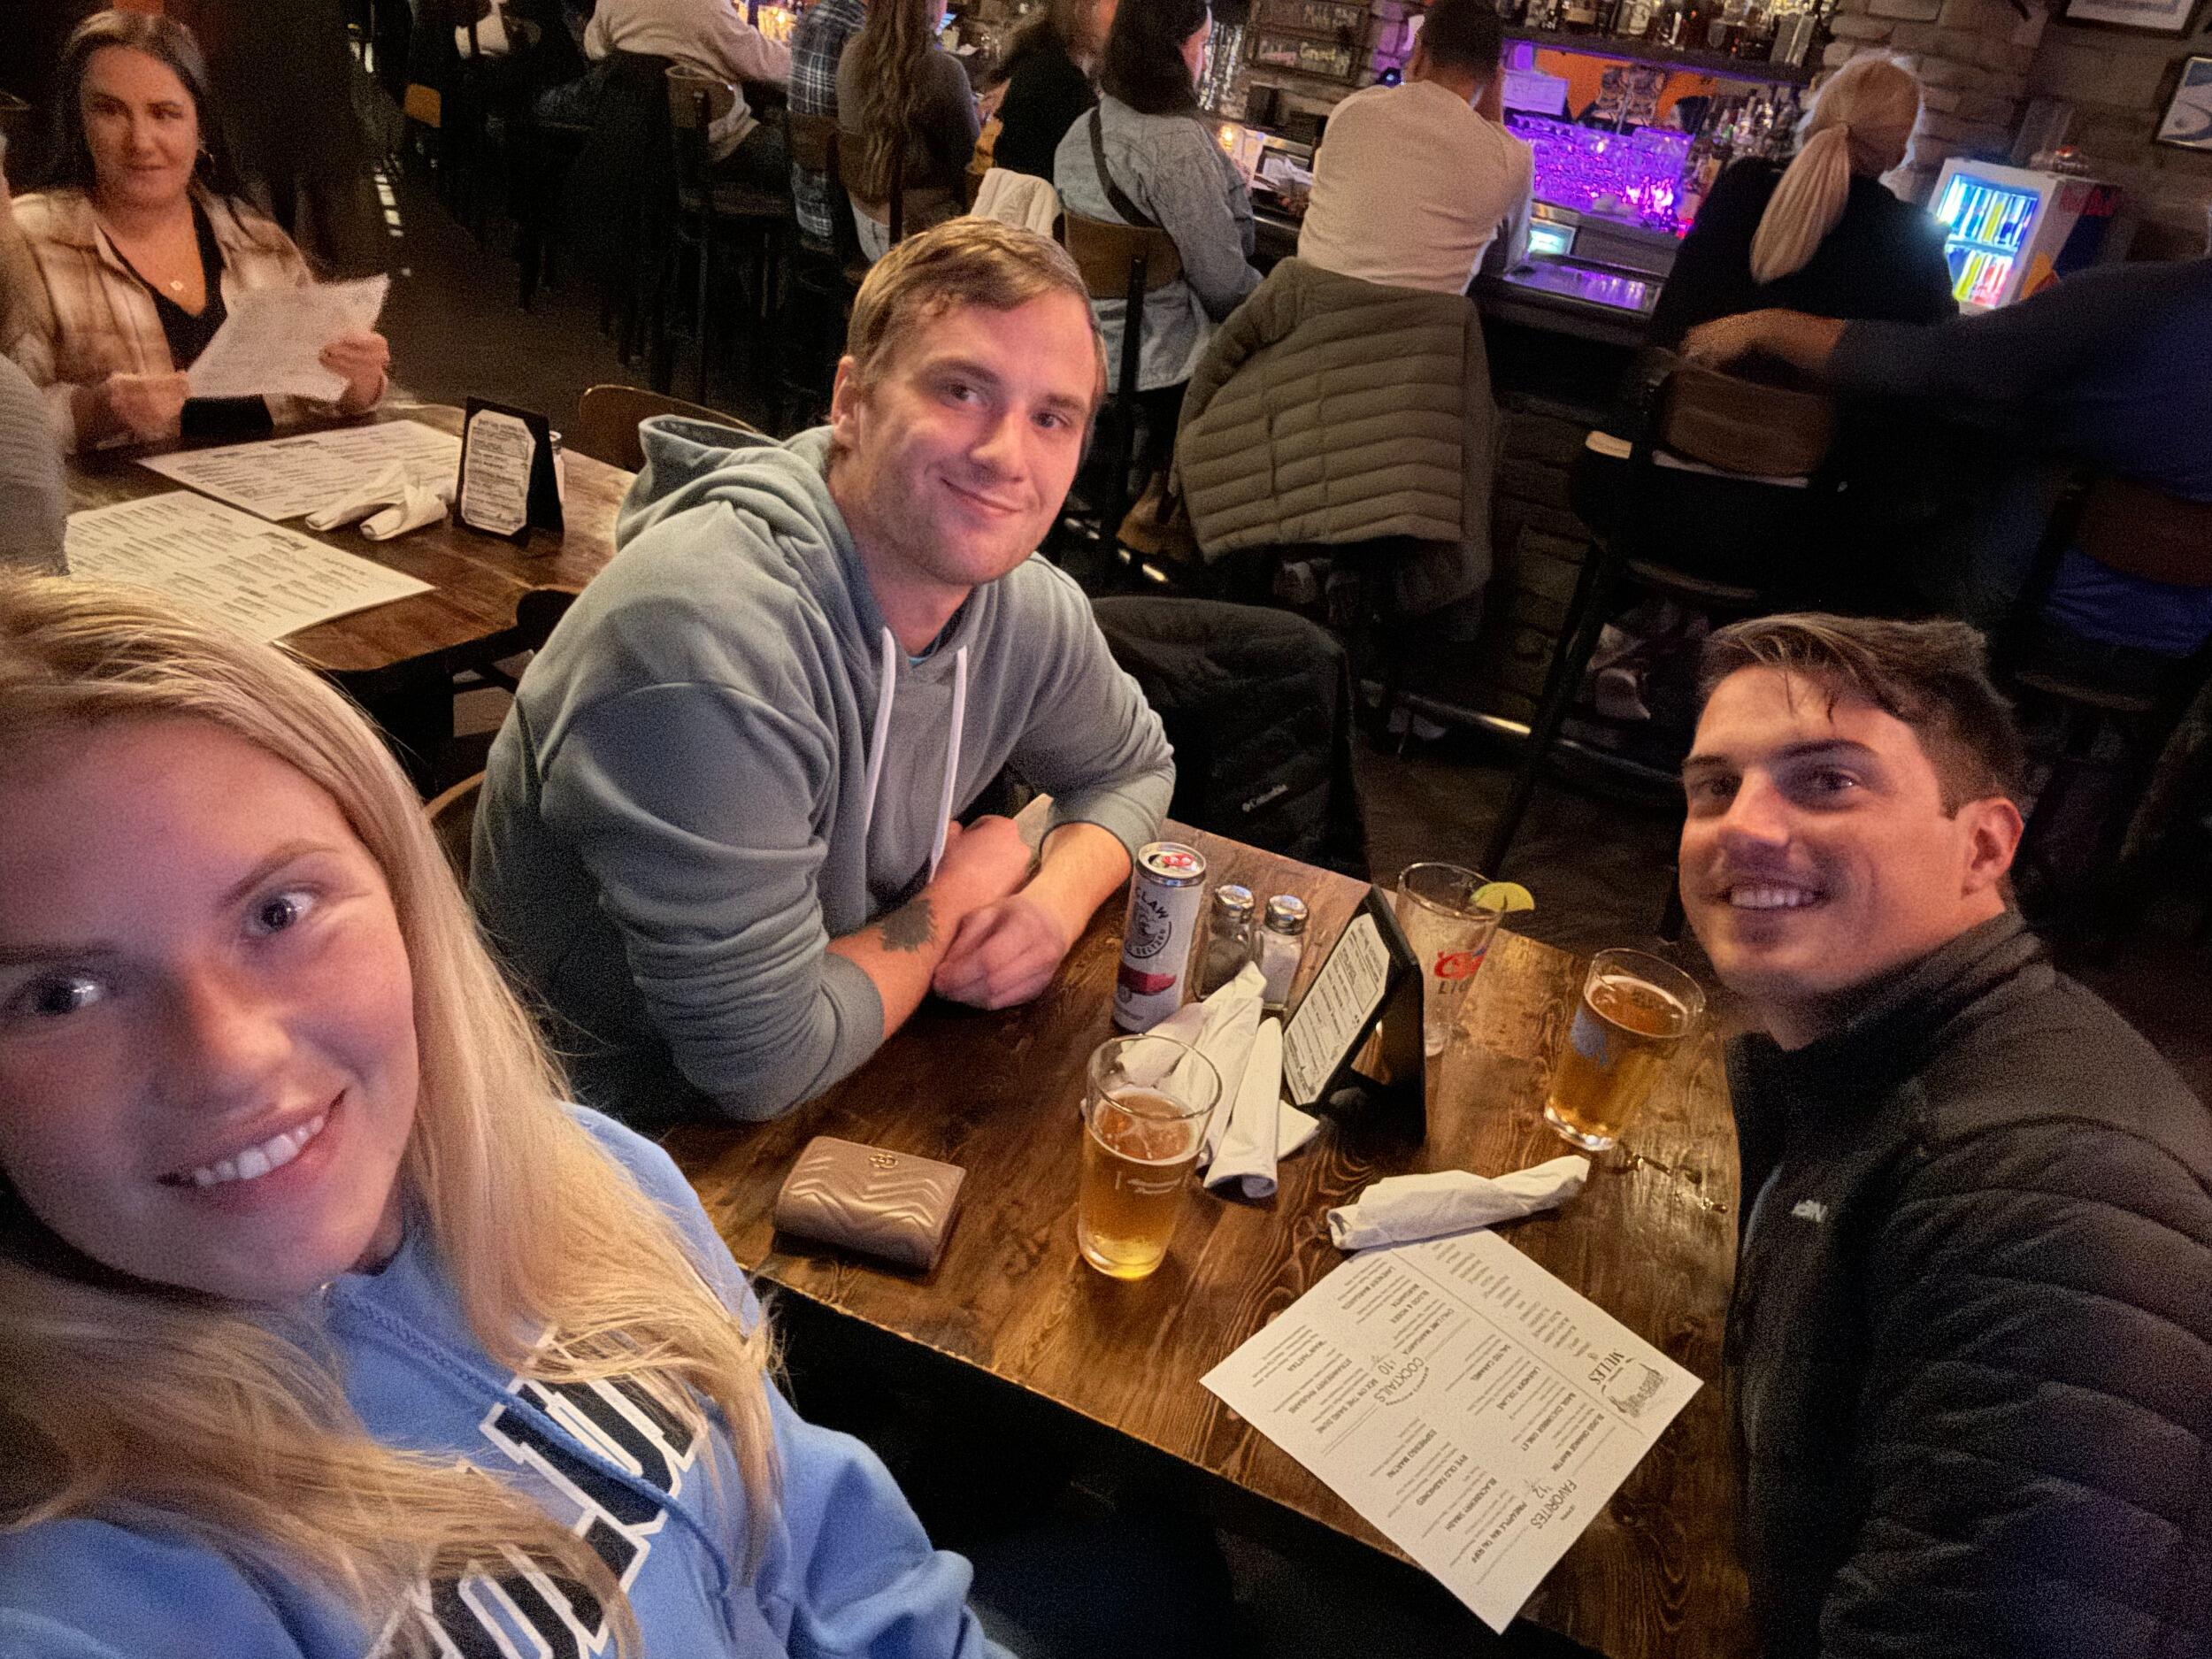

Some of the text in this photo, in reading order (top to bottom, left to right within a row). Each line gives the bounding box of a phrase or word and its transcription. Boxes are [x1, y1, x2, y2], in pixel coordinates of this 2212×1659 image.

[1134, 886, 1169, 919] CLAW
[1402, 1328, 1432, 1356] MARGARITA
[1314, 1357, 1352, 1392] STRAWBERRY
[1470, 1343, 1510, 1383] SALTED CARAMEL
[1586, 1348, 1624, 1386] MULES
[1372, 1356, 1425, 1403] COCKTAILS
[1515, 1365, 1540, 1391] LAVENDER
[1345, 1394, 1358, 1407] THE
[1495, 1389, 1518, 1410] COLLINS
[1536, 1405, 1563, 1433] CUCUMBER
[1586, 1413, 1604, 1432] BLOOD
[1406, 1428, 1437, 1458] ESPRESSO
[1569, 1429, 1590, 1451] ORANGE
[1386, 1455, 1410, 1479] MARTINI
[1550, 1449, 1572, 1472] MARTINI
[1415, 1453, 1468, 1506] RYE OLD FASHIONED
[1462, 1477, 1497, 1513] BLACKBERRY
[1528, 1479, 1577, 1530] FAVORITES
[1444, 1511, 1465, 1532] SMASH
[1498, 1501, 1527, 1531] PINEAPPLE
